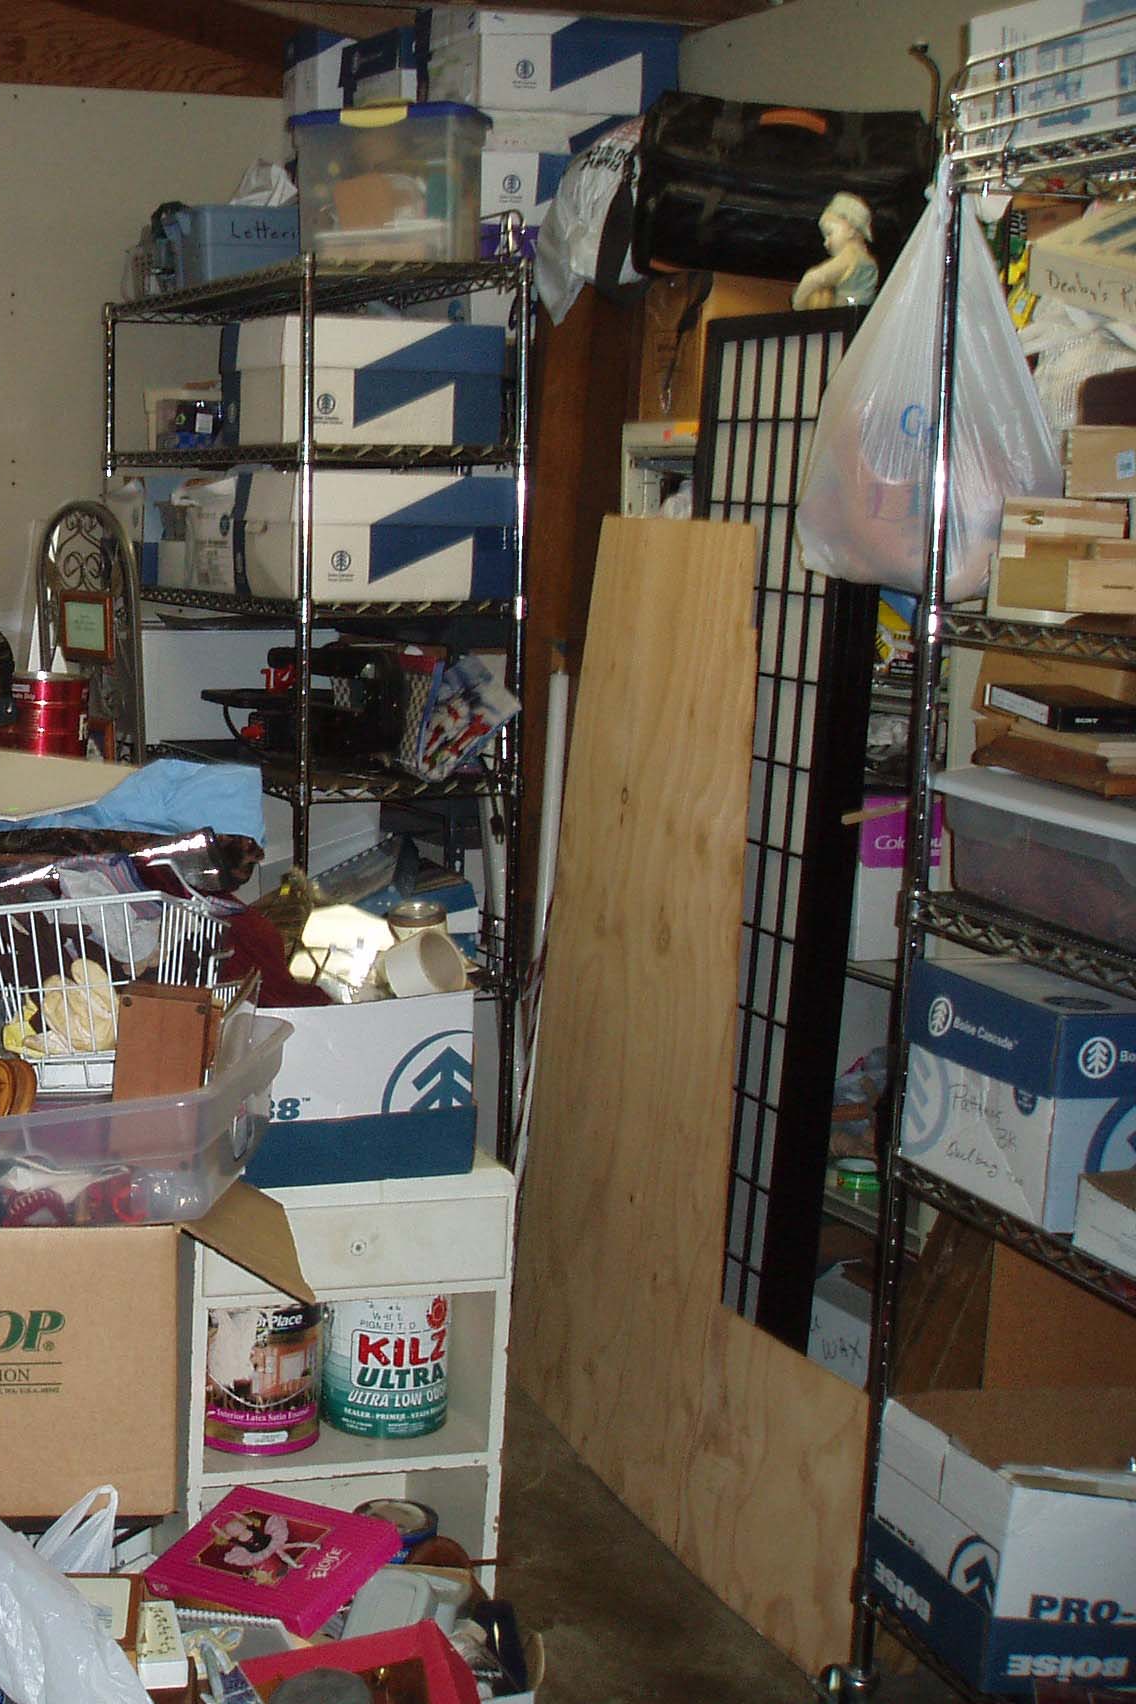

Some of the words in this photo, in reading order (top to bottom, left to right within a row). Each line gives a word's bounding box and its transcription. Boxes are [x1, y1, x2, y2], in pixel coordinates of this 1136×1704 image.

[358, 1327, 447, 1368] KILZ
[356, 1363, 445, 1390] ULTRA
[347, 1389, 390, 1408] ULTRA
[394, 1391, 423, 1409] LOW
[1029, 1593, 1136, 1624] PRO-
